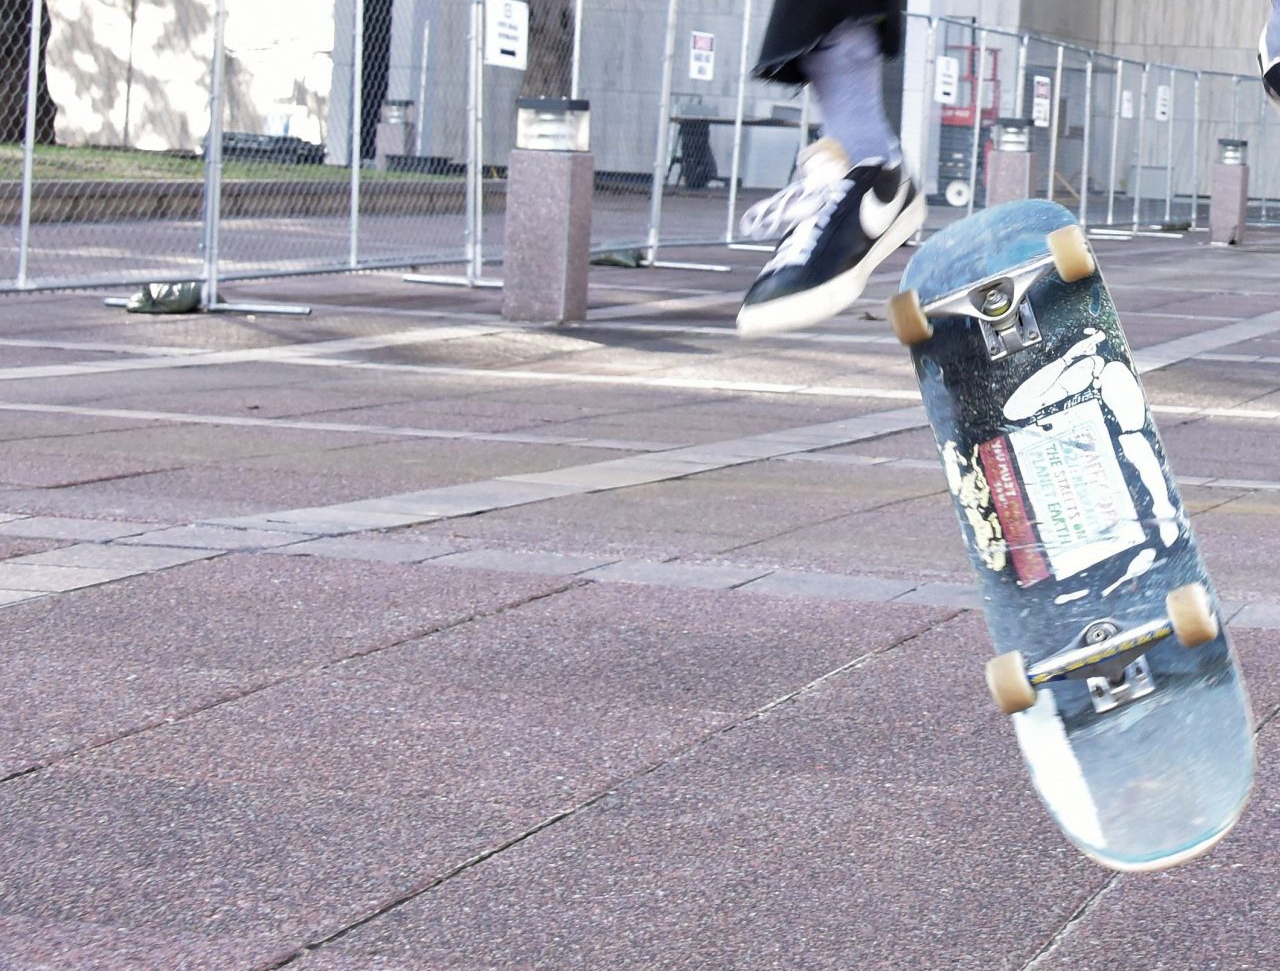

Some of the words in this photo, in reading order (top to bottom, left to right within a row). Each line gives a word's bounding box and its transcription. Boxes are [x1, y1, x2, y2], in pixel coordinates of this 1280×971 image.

[1030, 449, 1056, 501] PLANET
[1047, 501, 1071, 545] EARTH
[1044, 442, 1061, 467] THE
[1054, 468, 1079, 520] STREETS
